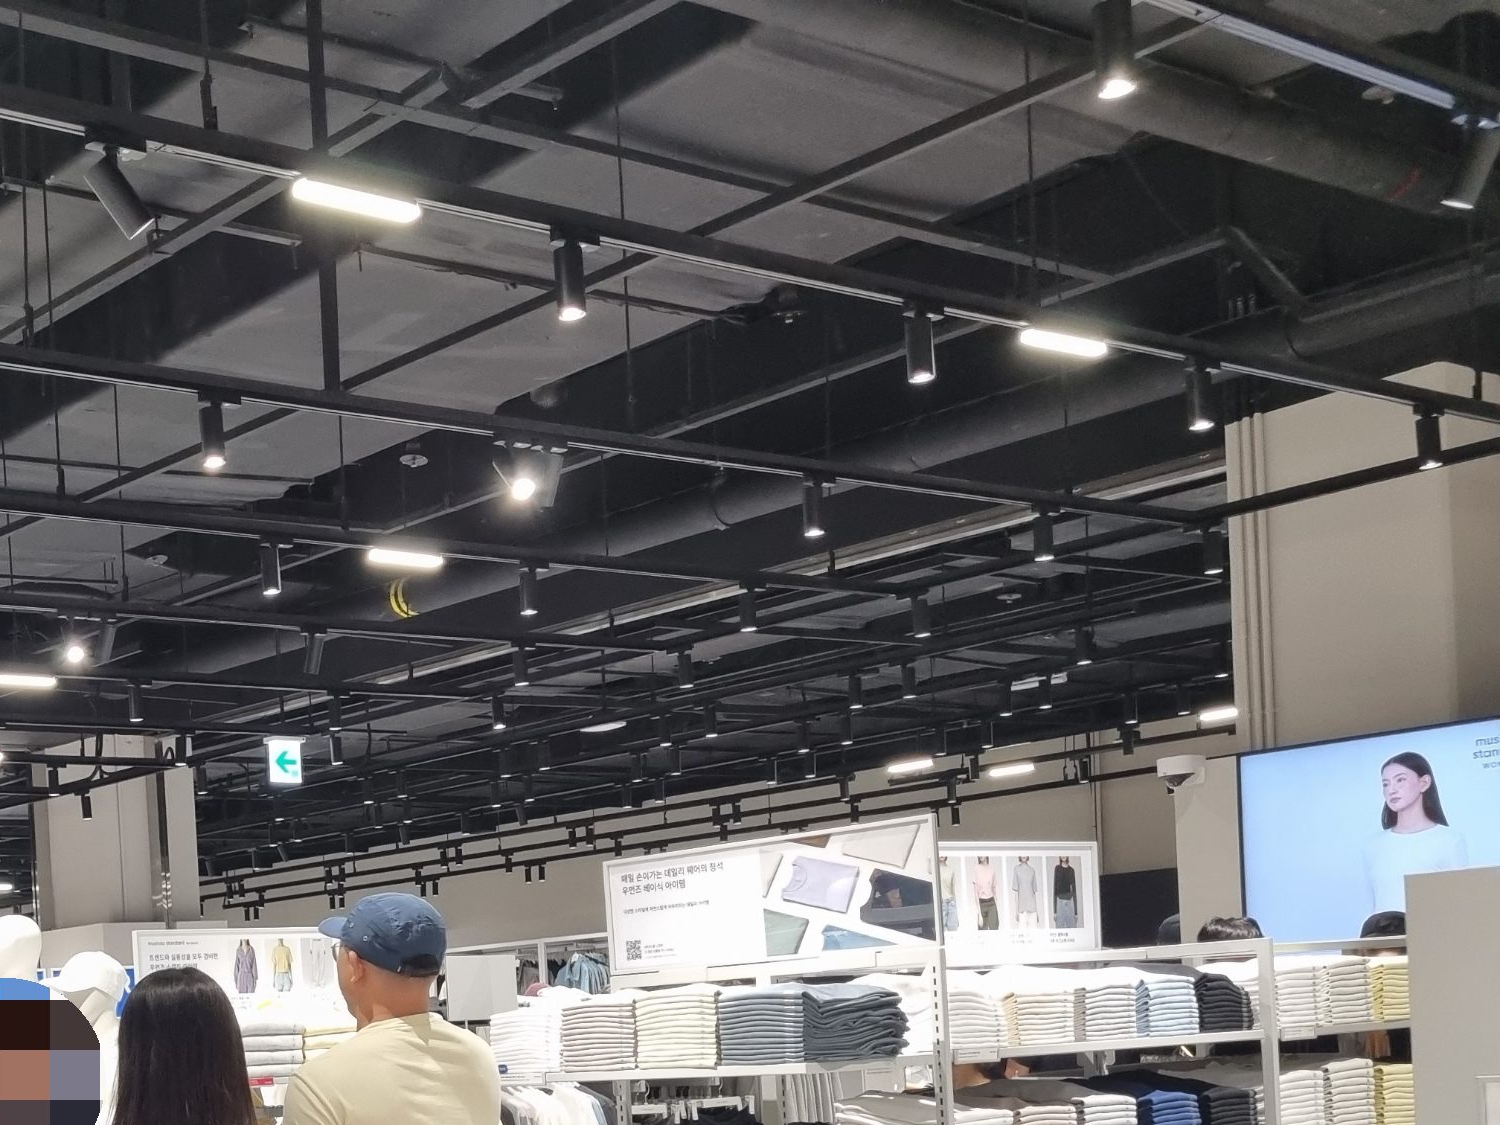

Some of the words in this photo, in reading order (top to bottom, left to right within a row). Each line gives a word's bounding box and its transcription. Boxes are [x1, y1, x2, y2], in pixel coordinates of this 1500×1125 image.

[1482, 761, 1500, 769] wo
[664, 866, 685, 877] 데일리
[687, 863, 708, 875] 웨어의
[709, 861, 724, 872] 정석
[622, 885, 642, 895] 우먼즈
[643, 882, 664, 892] 베이식
[665, 879, 686, 889] 아이템
